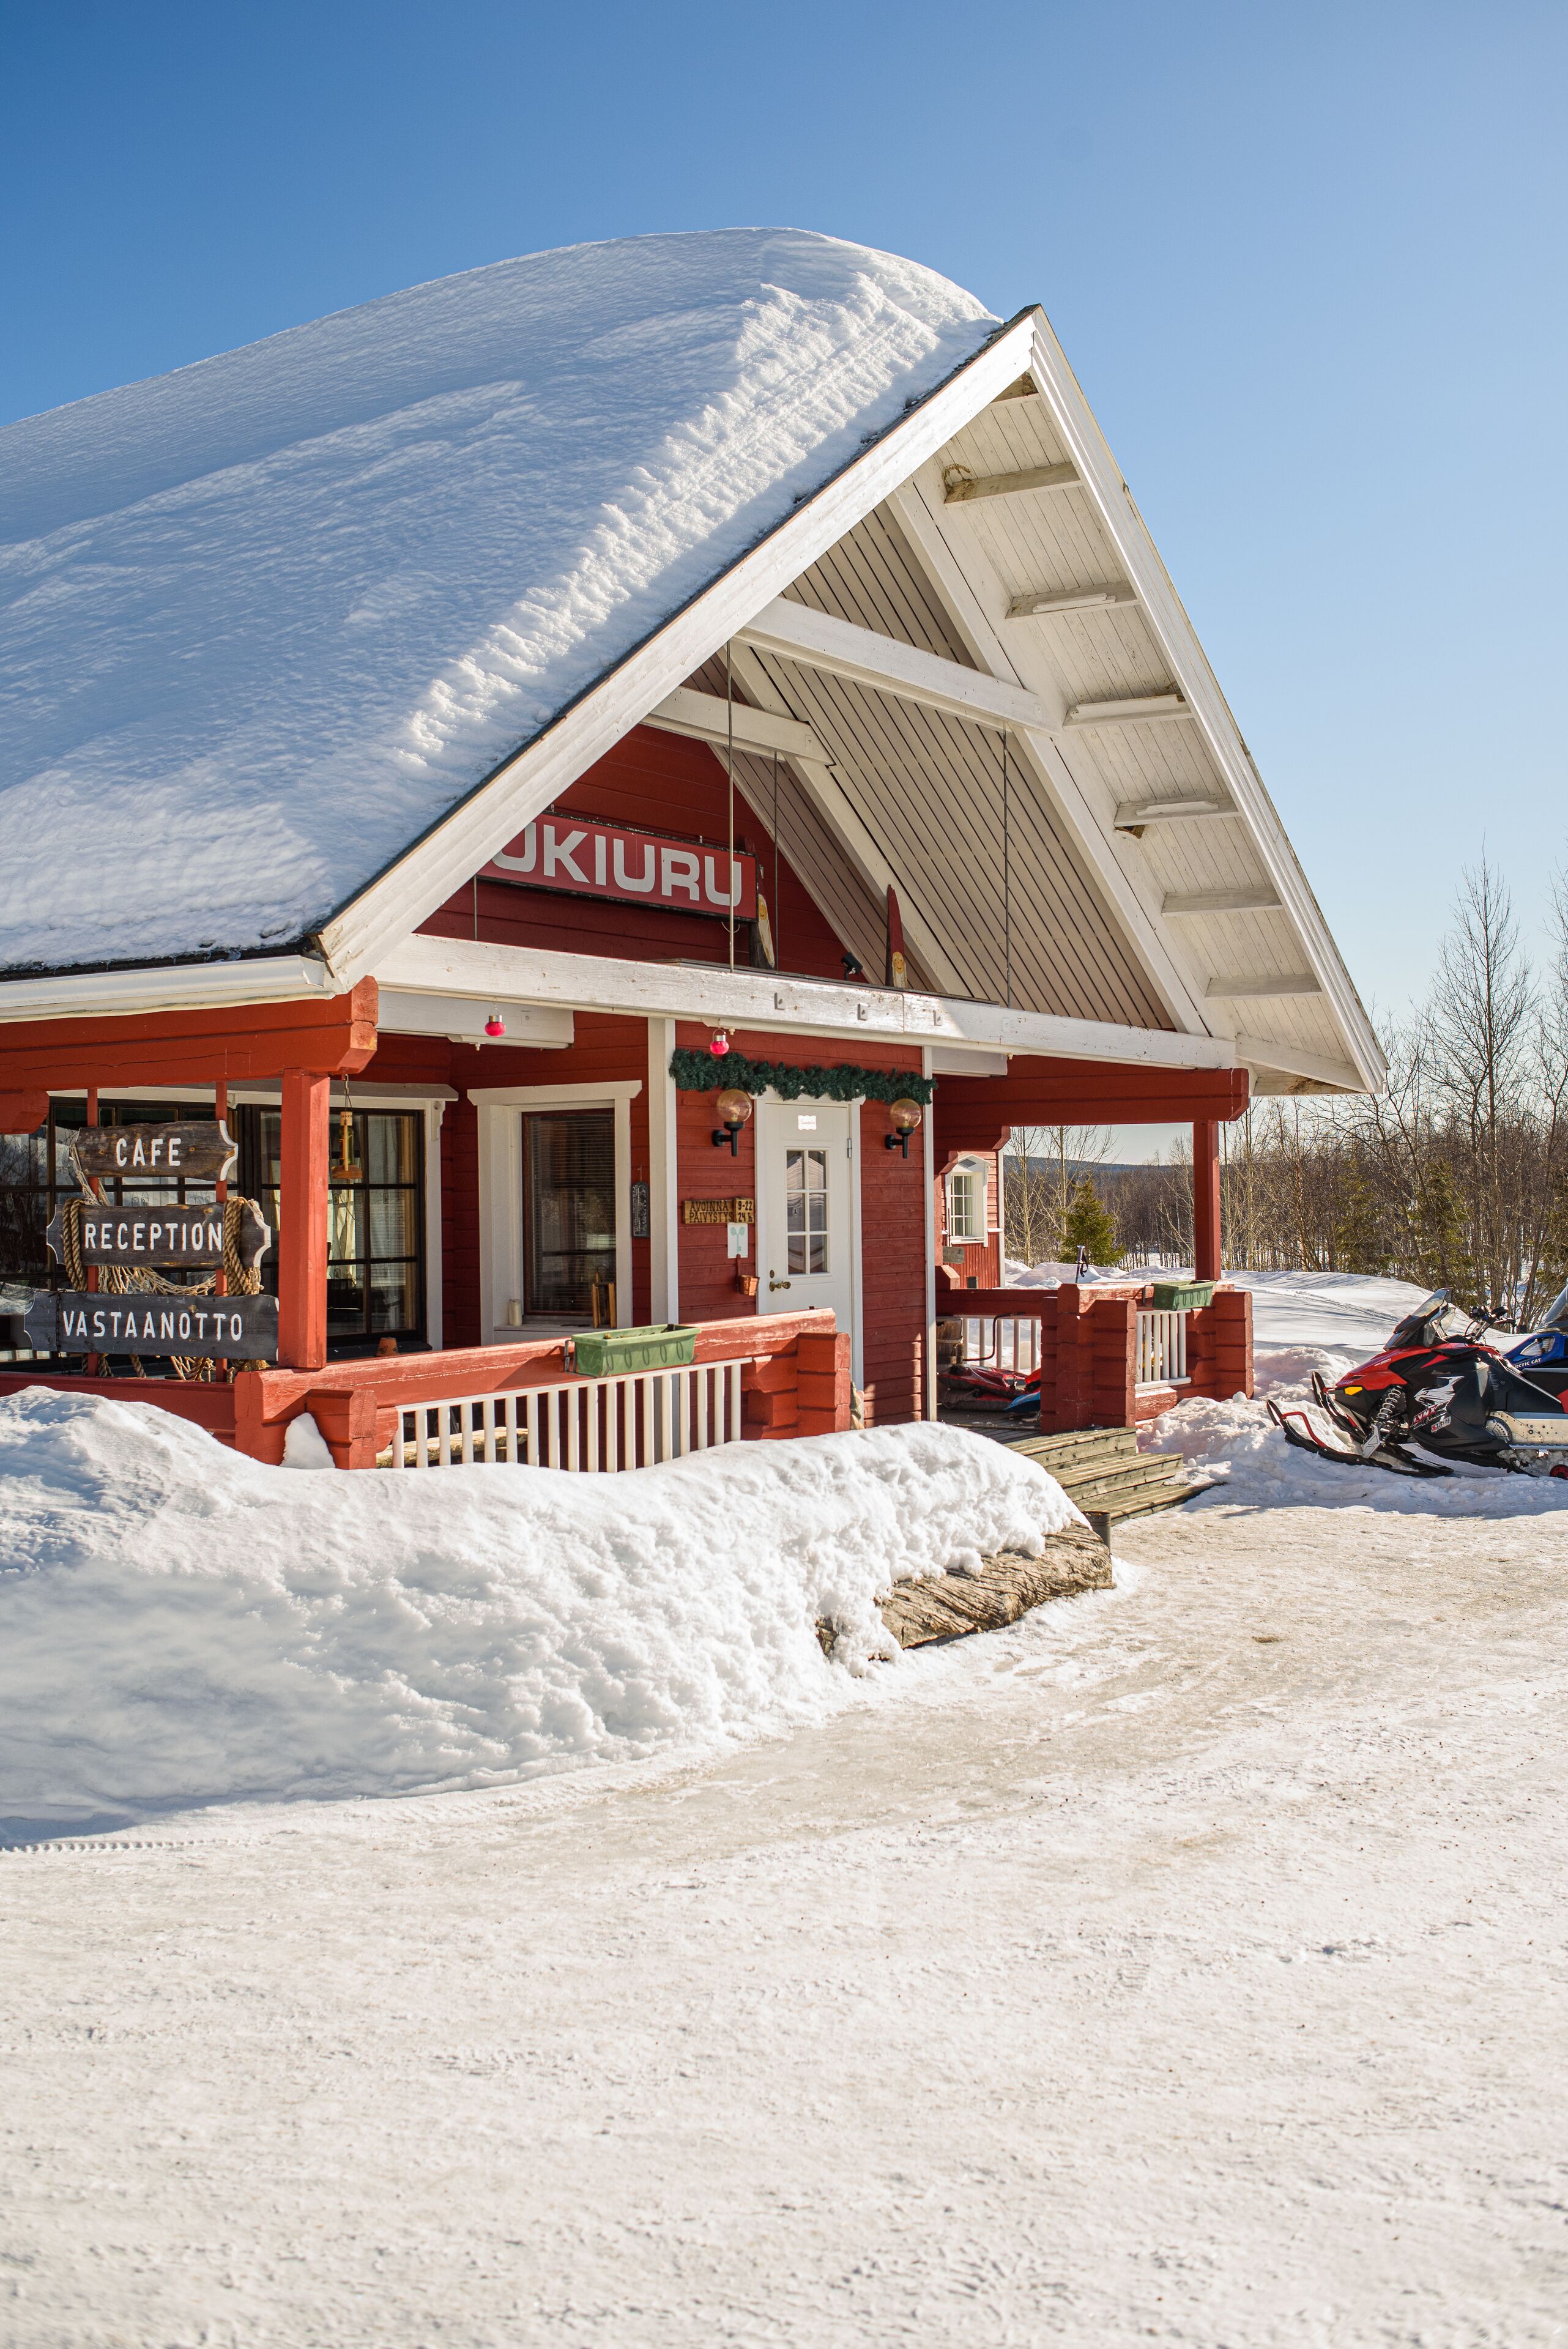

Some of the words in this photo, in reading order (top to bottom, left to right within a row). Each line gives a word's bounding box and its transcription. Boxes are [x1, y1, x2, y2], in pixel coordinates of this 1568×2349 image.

[116, 1138, 181, 1167] CAFE
[689, 1200, 729, 1212] AVOINNA
[738, 1200, 752, 1211] 9-22
[738, 1212, 746, 1222] 24
[748, 1212, 752, 1222] h
[85, 1223, 221, 1252] RECEPTION
[63, 1311, 242, 1341] VASTAANOTTO
[1413, 1404, 1438, 1424] LYNX
